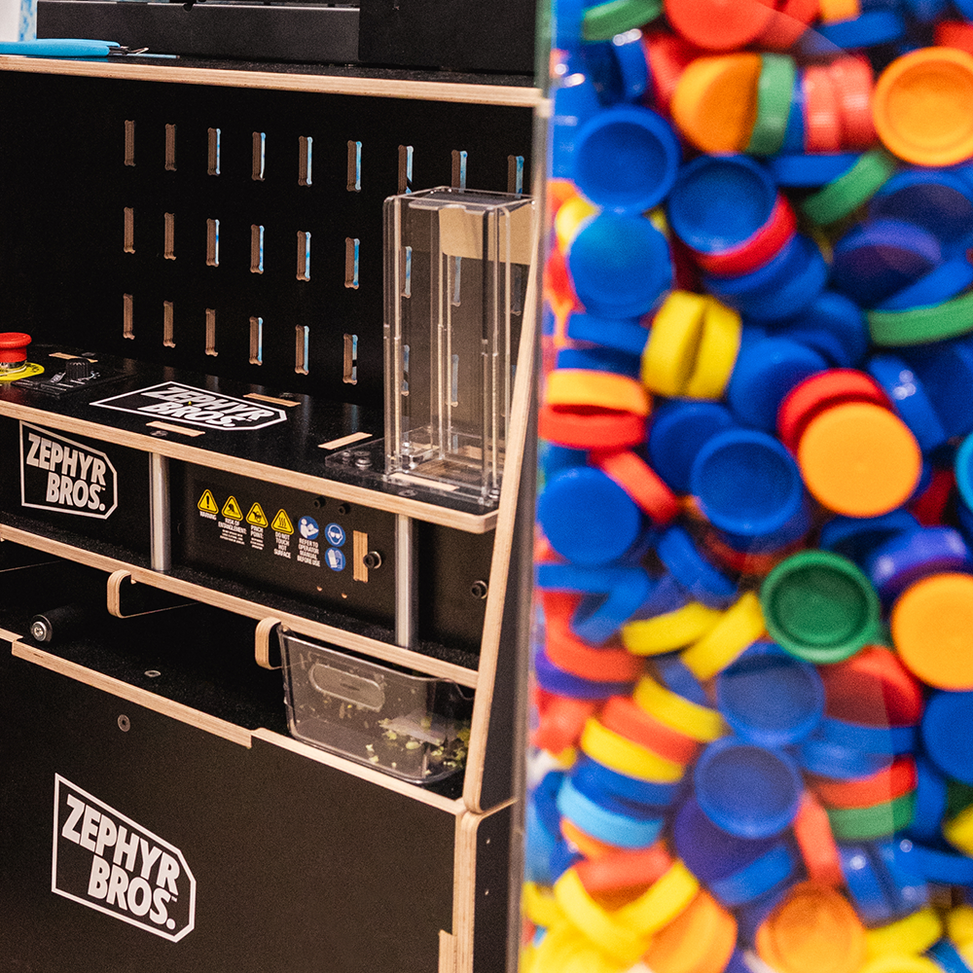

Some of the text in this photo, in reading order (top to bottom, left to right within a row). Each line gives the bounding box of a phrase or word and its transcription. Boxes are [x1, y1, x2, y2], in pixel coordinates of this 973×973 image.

[137, 401, 245, 427] BROS.
[141, 386, 275, 421] ZEPHYR
[26, 432, 107, 486] ZEPHYR
[46, 471, 105, 512] BROS.
[62, 793, 181, 895] ZEPHYR
[87, 854, 176, 930] BROS.
